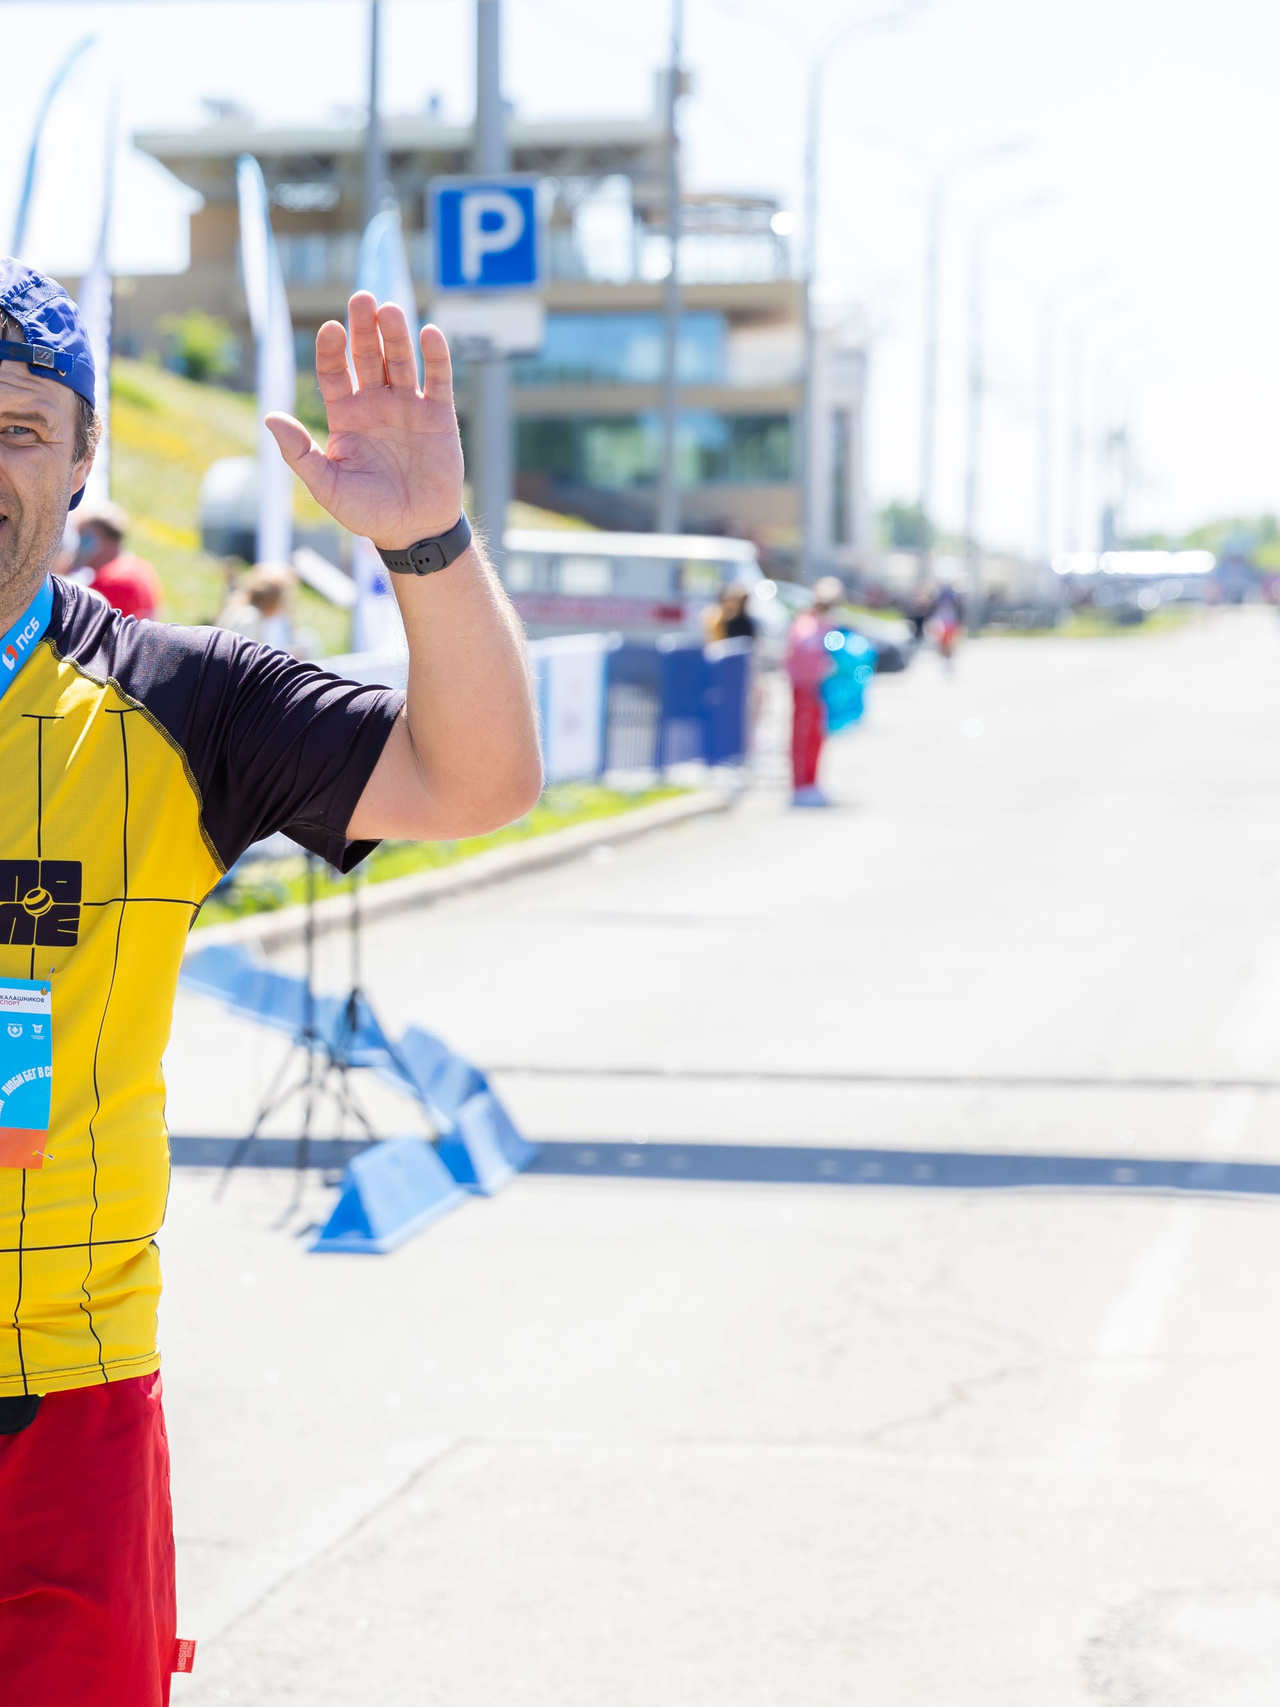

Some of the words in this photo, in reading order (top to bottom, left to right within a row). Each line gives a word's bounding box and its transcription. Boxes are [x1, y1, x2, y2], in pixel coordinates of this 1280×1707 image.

[460, 192, 526, 282] P
[15, 616, 40, 650] ПСБ
[0, 995, 45, 1003] КАЛАШНИКОВ
[1, 1073, 25, 1096] ЛЮБИ
[22, 1067, 37, 1082] БЕГ
[37, 1066, 45, 1079] В
